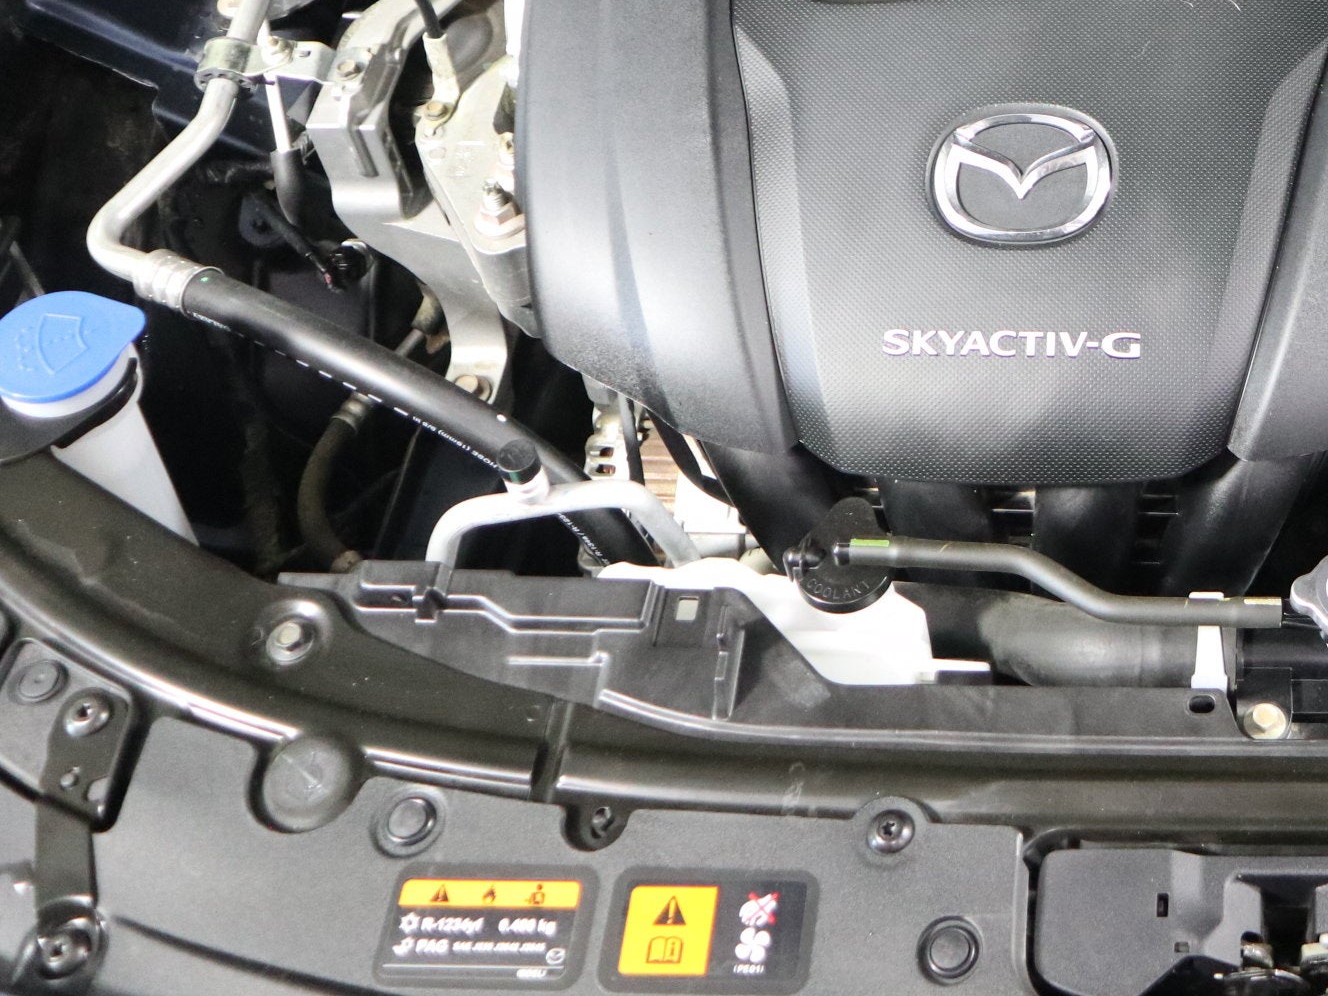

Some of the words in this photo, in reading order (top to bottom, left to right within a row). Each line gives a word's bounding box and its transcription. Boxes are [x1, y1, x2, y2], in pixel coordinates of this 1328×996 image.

[882, 329, 1141, 359] SKYACTIV-G
[471, 449, 499, 469] HOSE
[415, 937, 449, 955] PAG
